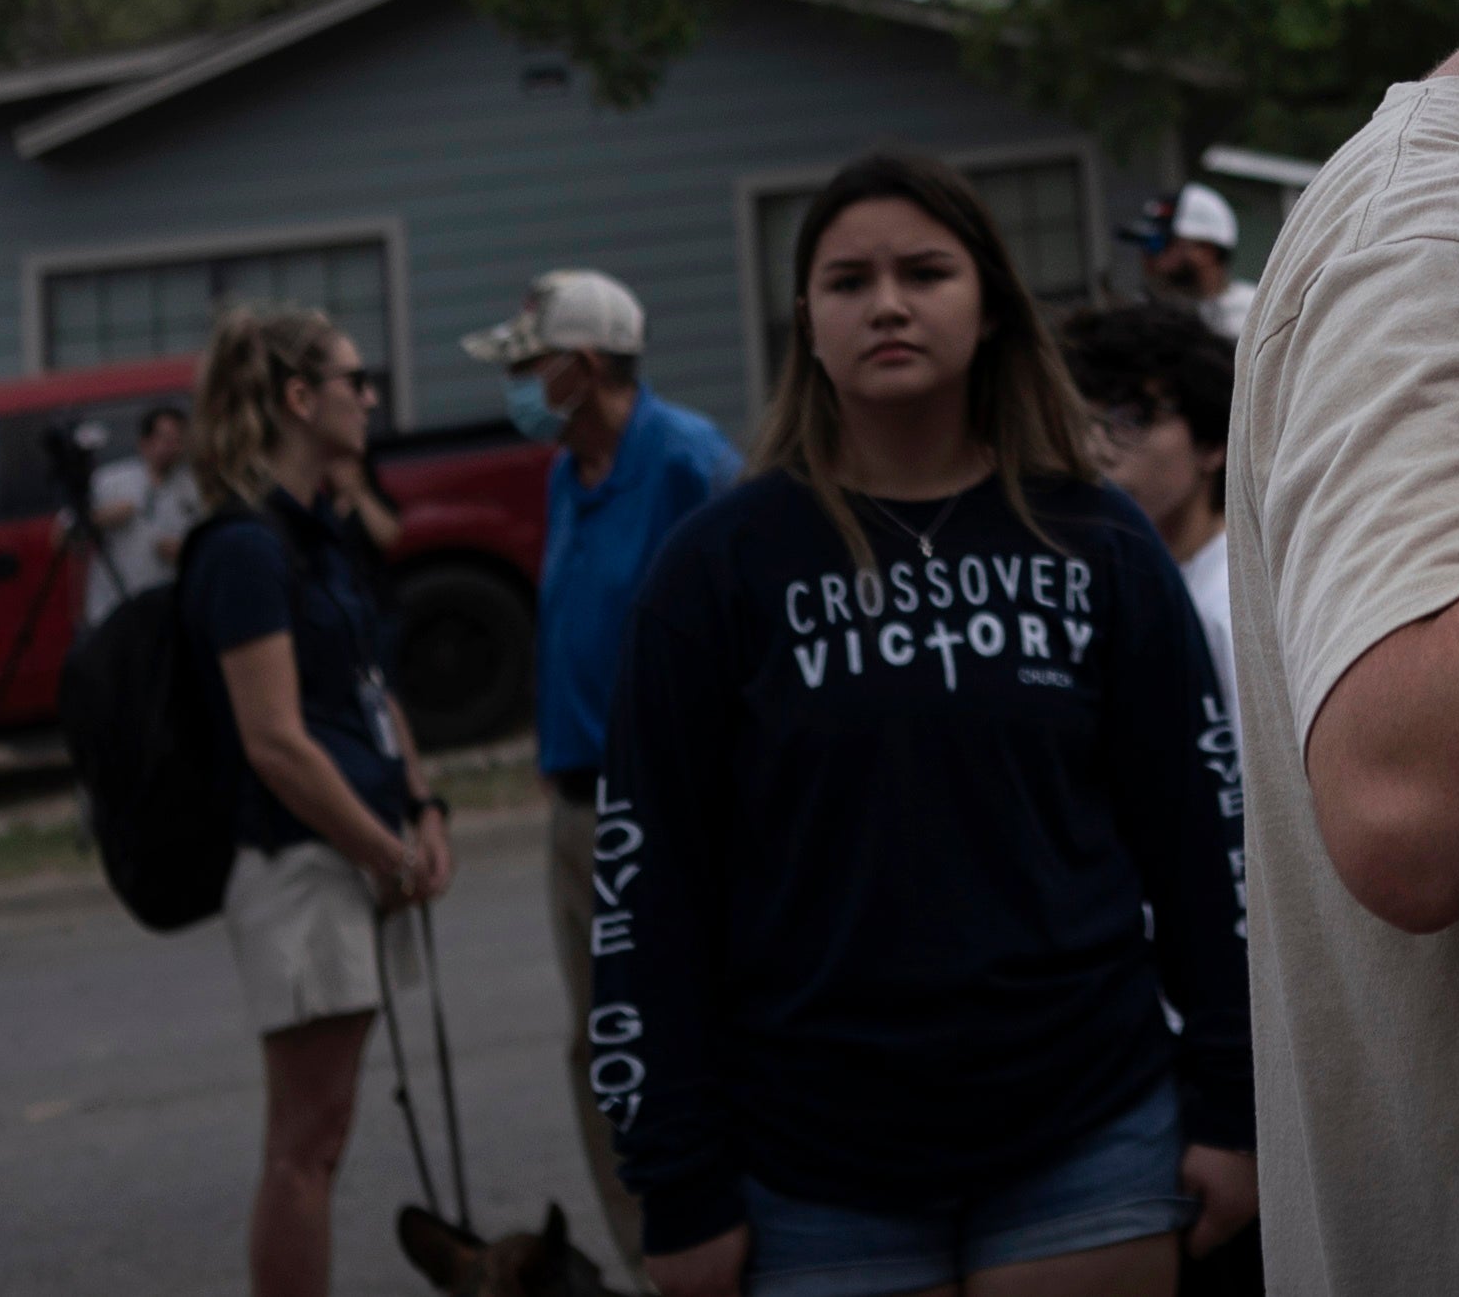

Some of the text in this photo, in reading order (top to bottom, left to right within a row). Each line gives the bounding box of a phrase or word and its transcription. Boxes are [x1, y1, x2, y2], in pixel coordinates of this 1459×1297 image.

[785, 553, 1093, 636] CROSSOVER
[793, 610, 1093, 693] VICTORY
[591, 773, 644, 956] LOVE
